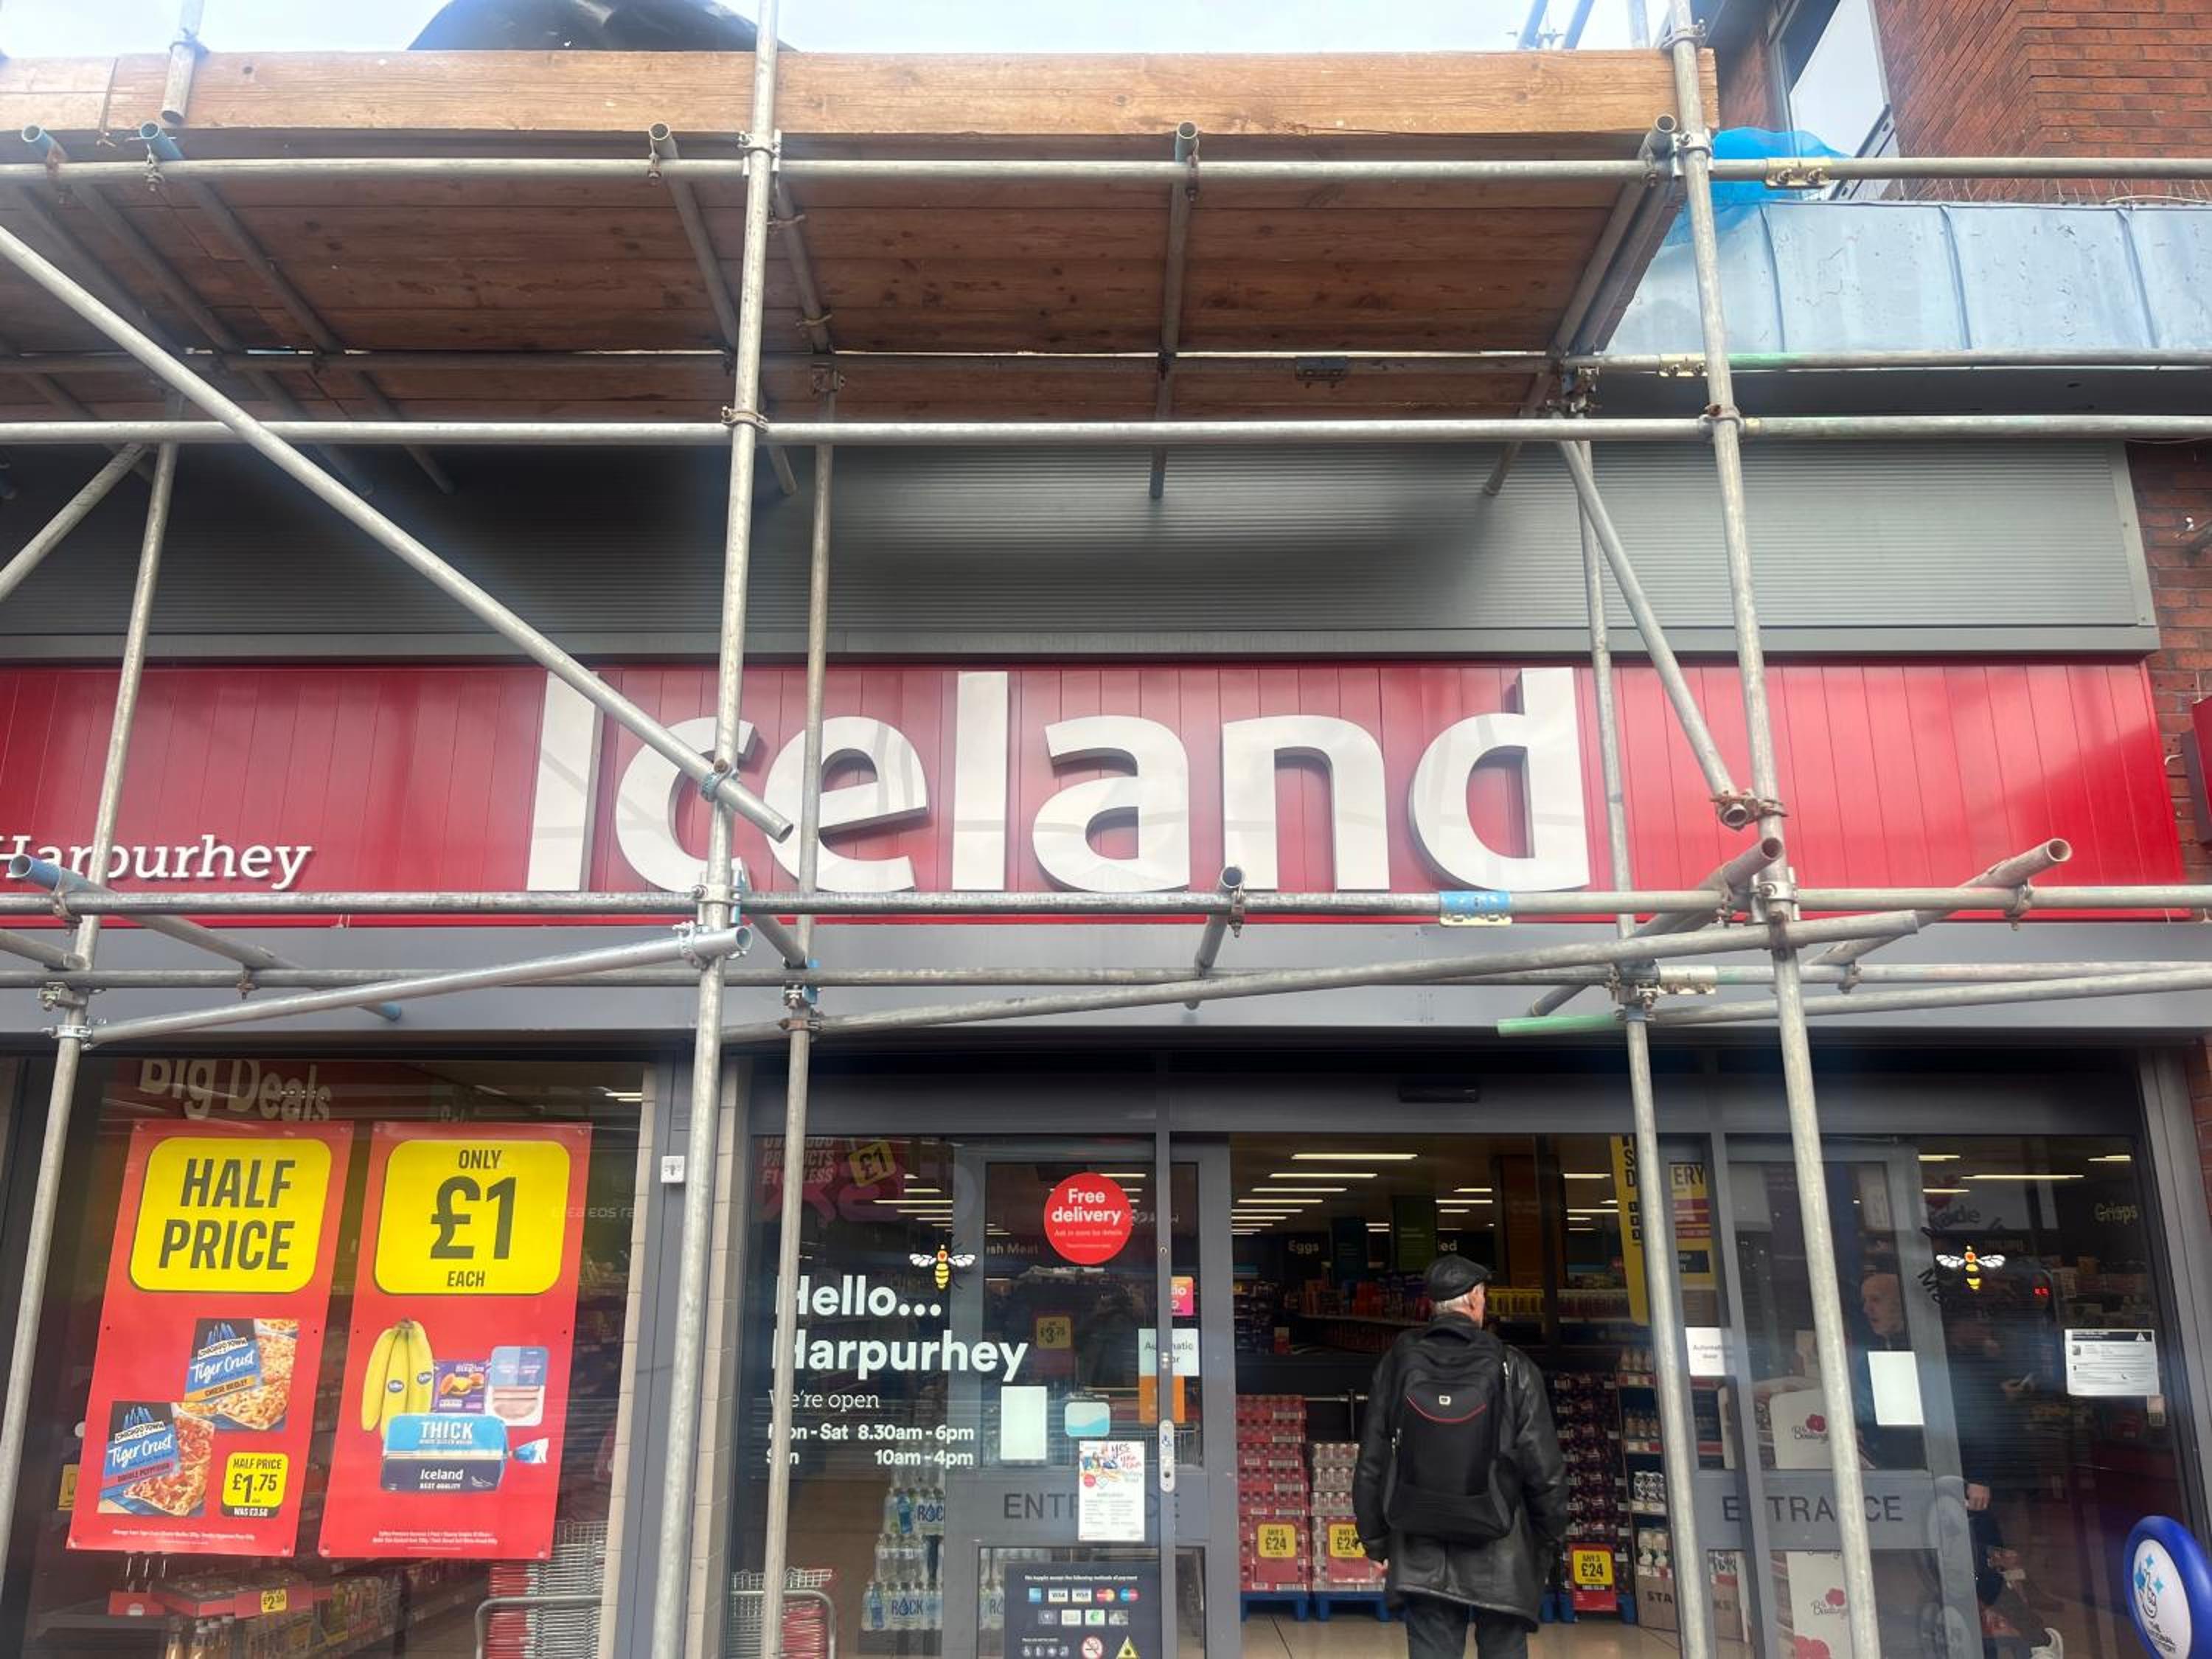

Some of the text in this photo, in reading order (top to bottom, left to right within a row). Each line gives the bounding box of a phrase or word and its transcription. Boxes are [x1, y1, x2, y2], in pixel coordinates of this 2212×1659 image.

[526, 666, 1590, 892] Iceland
[458, 1150, 503, 1170] ONLY
[180, 1158, 296, 1208] HALF
[1068, 1188, 1106, 1204] Free
[429, 1175, 517, 1260] £1
[1051, 1206, 1122, 1226] delivery
[2094, 1202, 2138, 1225] Crisps
[158, 1218, 296, 1270] PRICE
[1288, 1239, 1320, 1253] Eggs
[447, 1270, 486, 1287] EACH
[189, 1349, 255, 1384] Tiger Crust
[768, 1390, 880, 1413] e're open
[420, 1421, 473, 1439] THICK
[819, 1423, 849, 1440] Sat
[858, 1424, 922, 1440] 8.30am
[935, 1424, 974, 1444] 6pm
[108, 1433, 173, 1468] Tiger Crust
[766, 1450, 799, 1466] Sn
[874, 1449, 921, 1466] 10am
[933, 1449, 973, 1470] 4pm
[232, 1458, 282, 1470] HALF PRICE
[420, 1468, 465, 1481] Iceland
[232, 1472, 278, 1503] £1.75
[1722, 1496, 1904, 1522] ETRACE
[1265, 1537, 1287, 1551] £24
[1337, 1537, 1358, 1551] £24
[1581, 1562, 1604, 1577] £24
